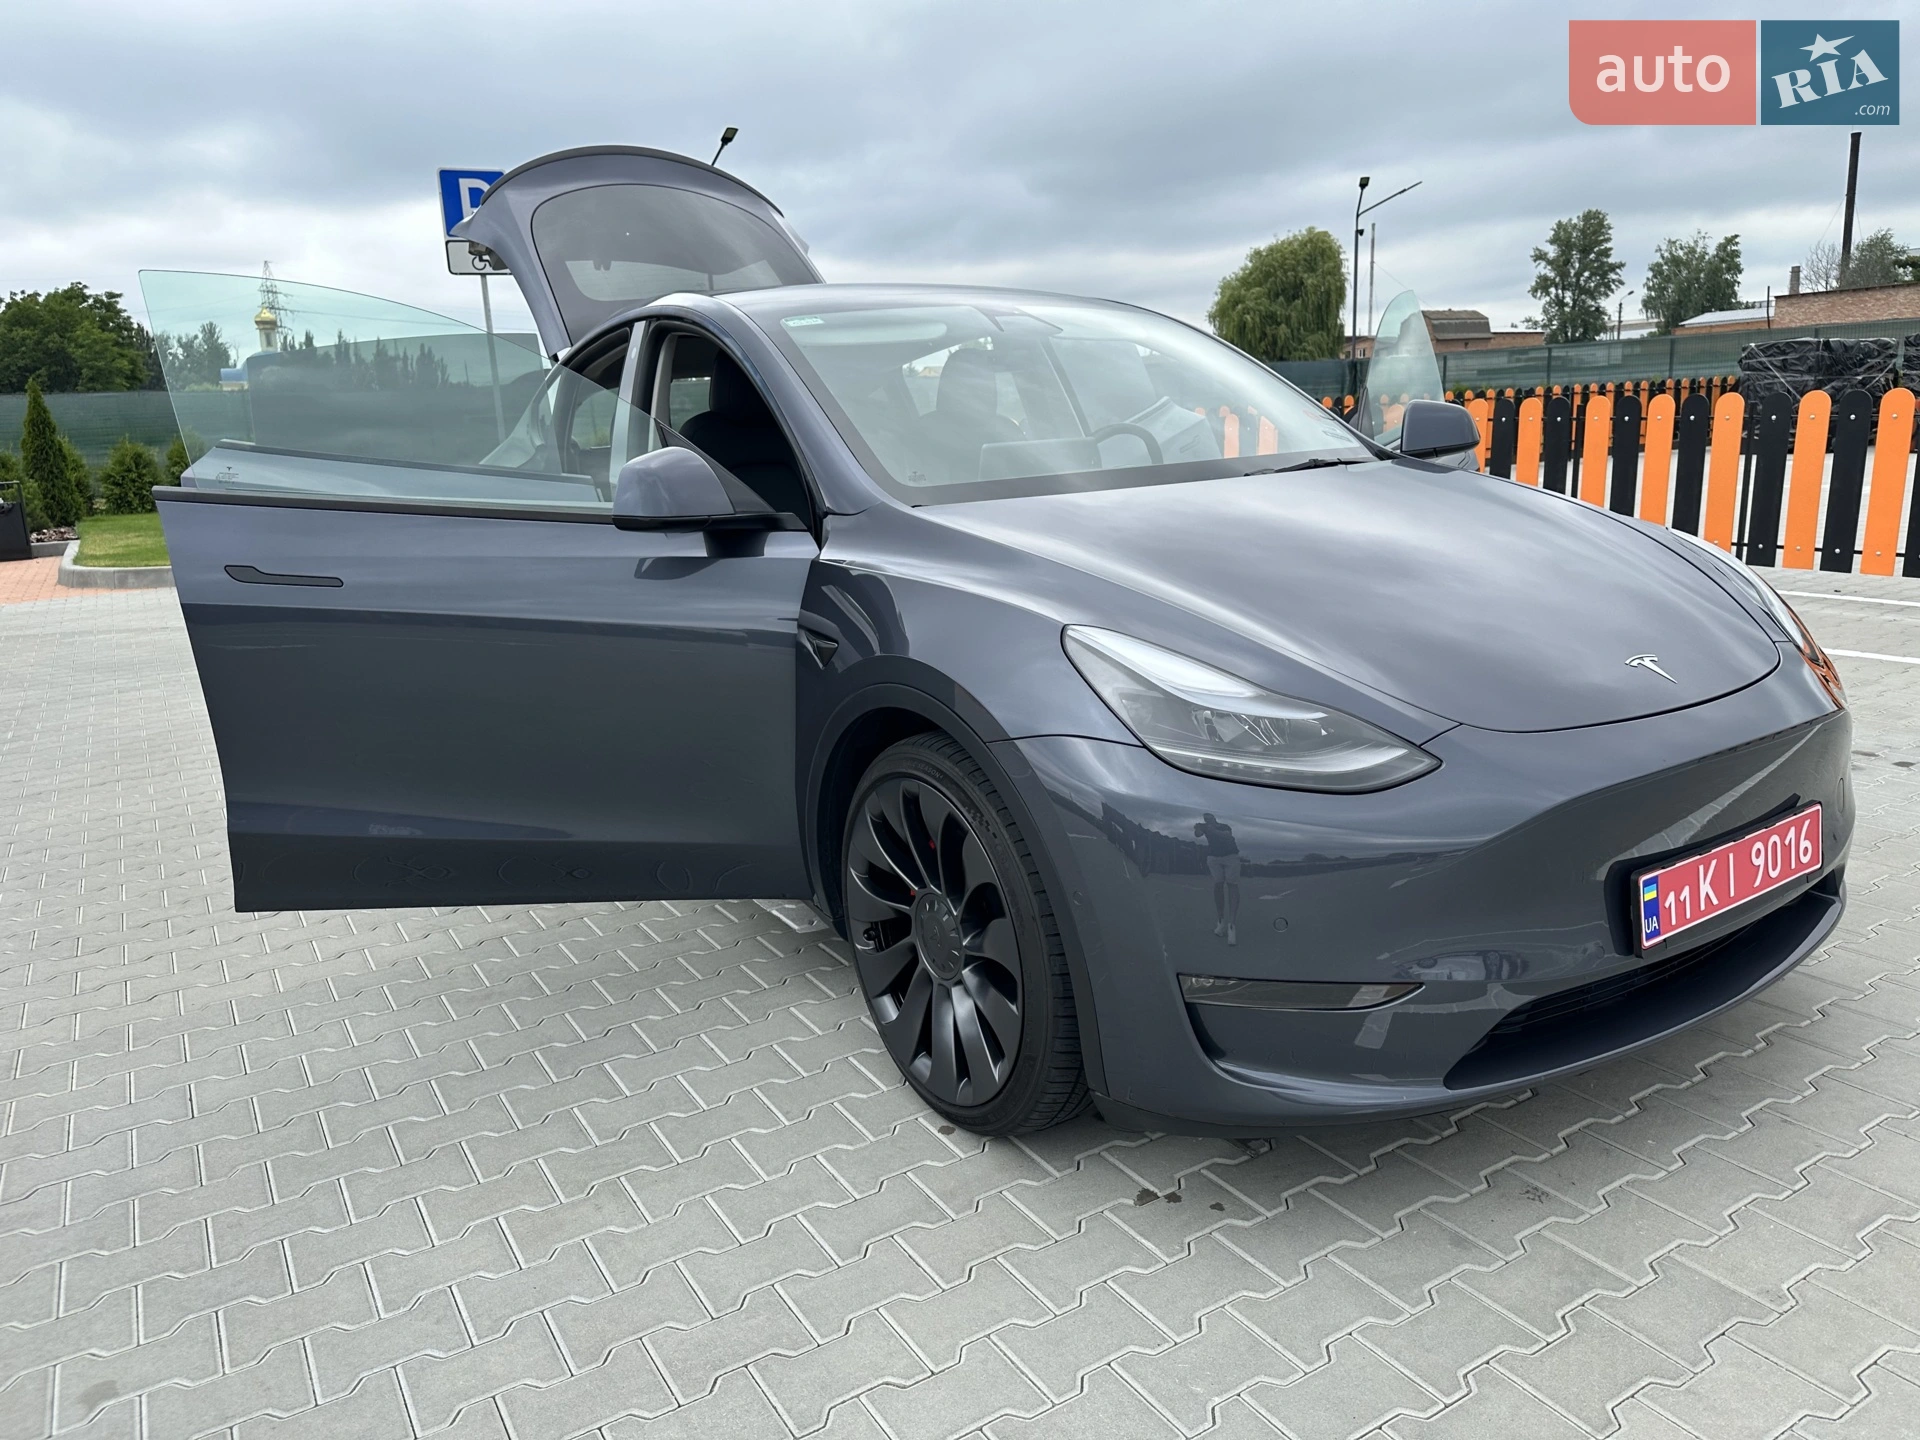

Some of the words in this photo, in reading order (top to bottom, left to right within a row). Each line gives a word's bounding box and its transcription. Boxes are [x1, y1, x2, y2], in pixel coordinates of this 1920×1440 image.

[458, 178, 491, 221] P
[1750, 818, 1813, 889] 9016
[1645, 915, 1659, 934] UA
